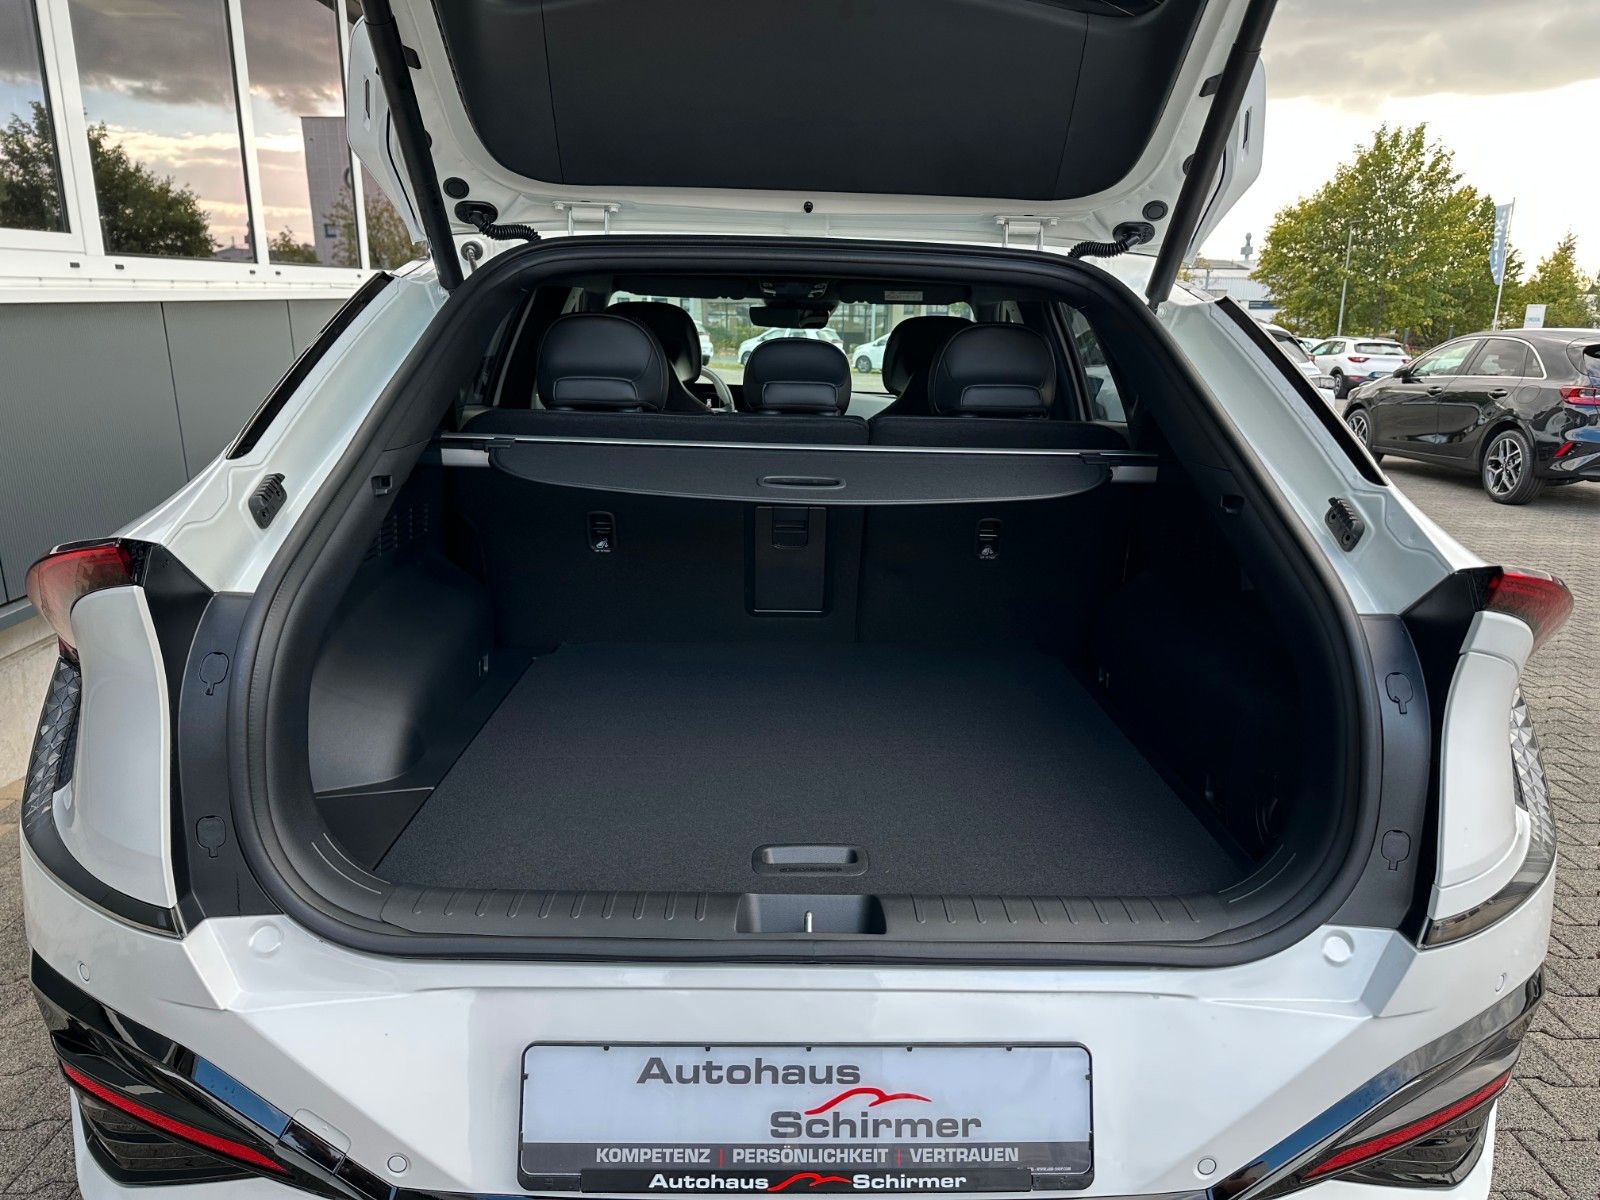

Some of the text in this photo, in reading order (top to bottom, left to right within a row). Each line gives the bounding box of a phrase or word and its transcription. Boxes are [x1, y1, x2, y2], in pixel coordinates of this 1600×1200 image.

[636, 1057, 861, 1085] Autohaus
[769, 1110, 982, 1139] Schirmer
[596, 1145, 1020, 1164] KOMPETENZ PERSÖNLICHKEIT VERTRAUEN
[648, 1173, 967, 1189] Autohaus Schirmer
